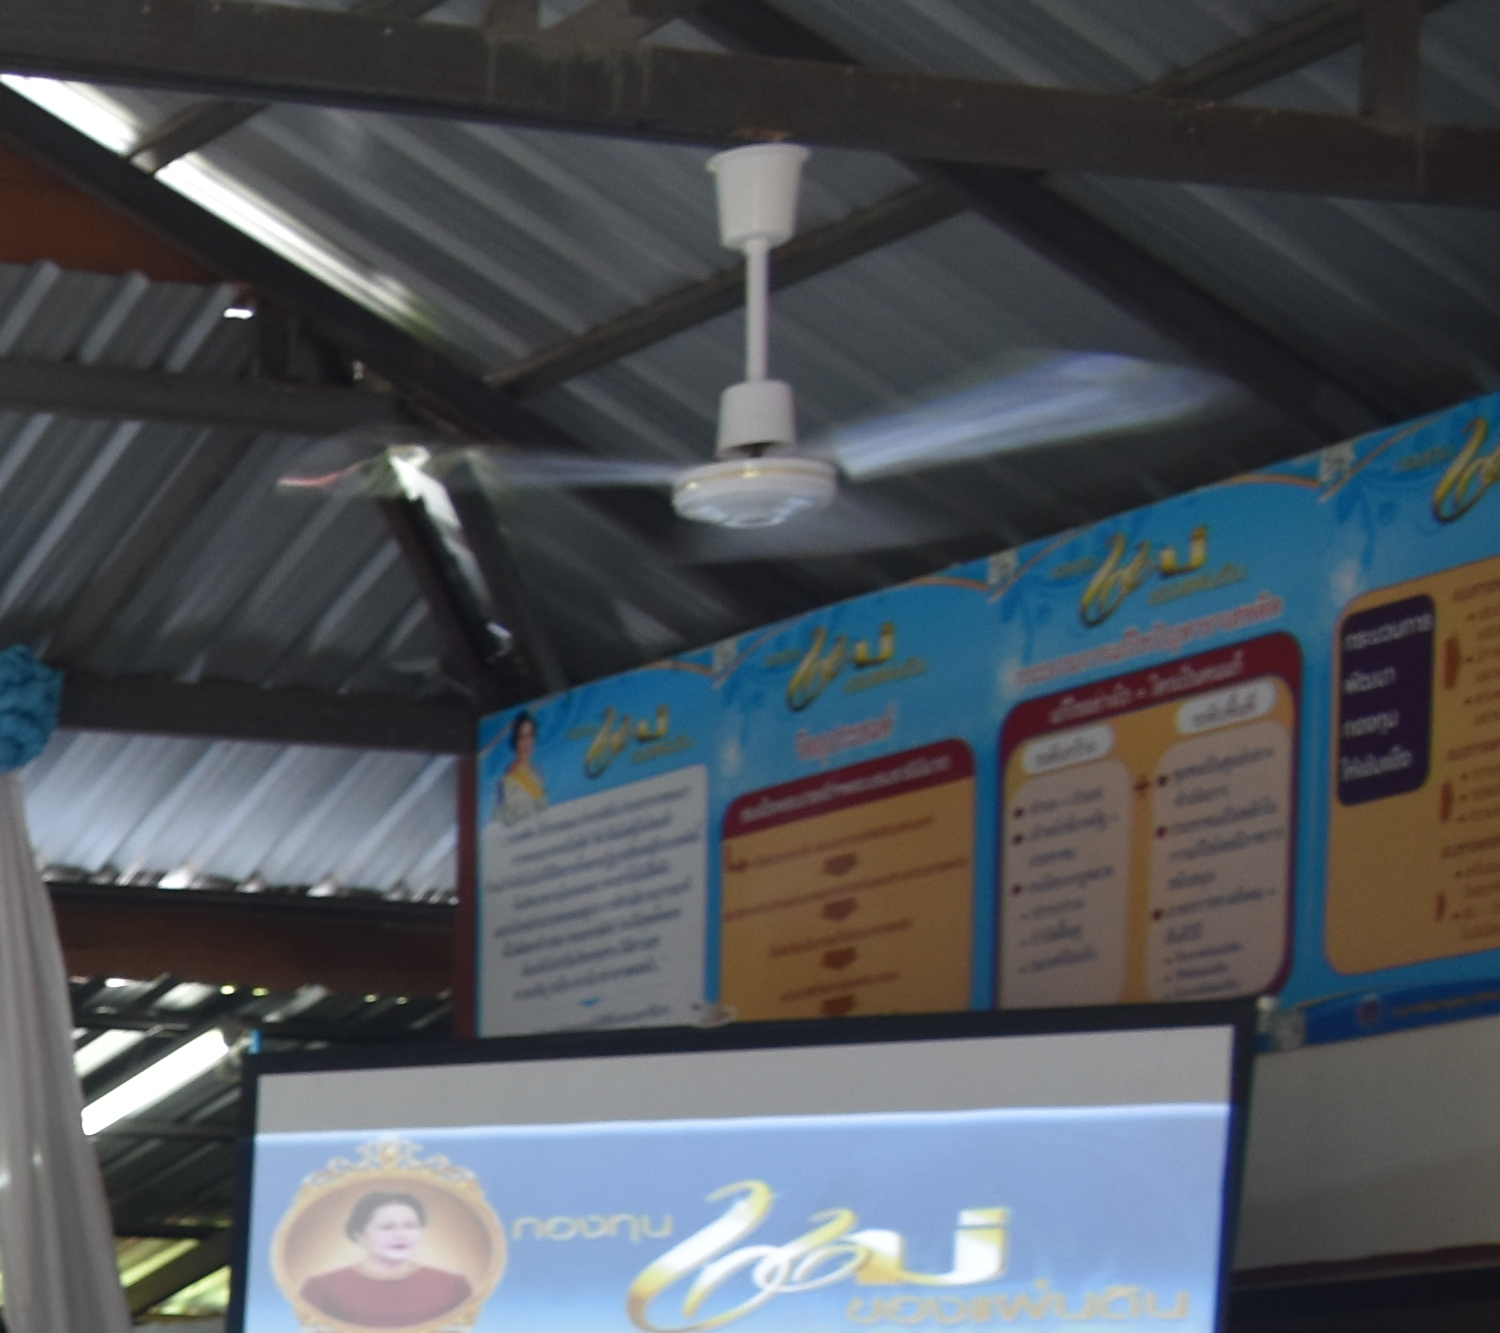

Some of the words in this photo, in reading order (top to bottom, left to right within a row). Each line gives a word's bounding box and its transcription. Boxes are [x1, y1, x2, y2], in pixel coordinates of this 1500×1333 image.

[512, 1211, 674, 1244] กองทุน
[845, 1278, 1191, 1324] ของแผ่นดิน
